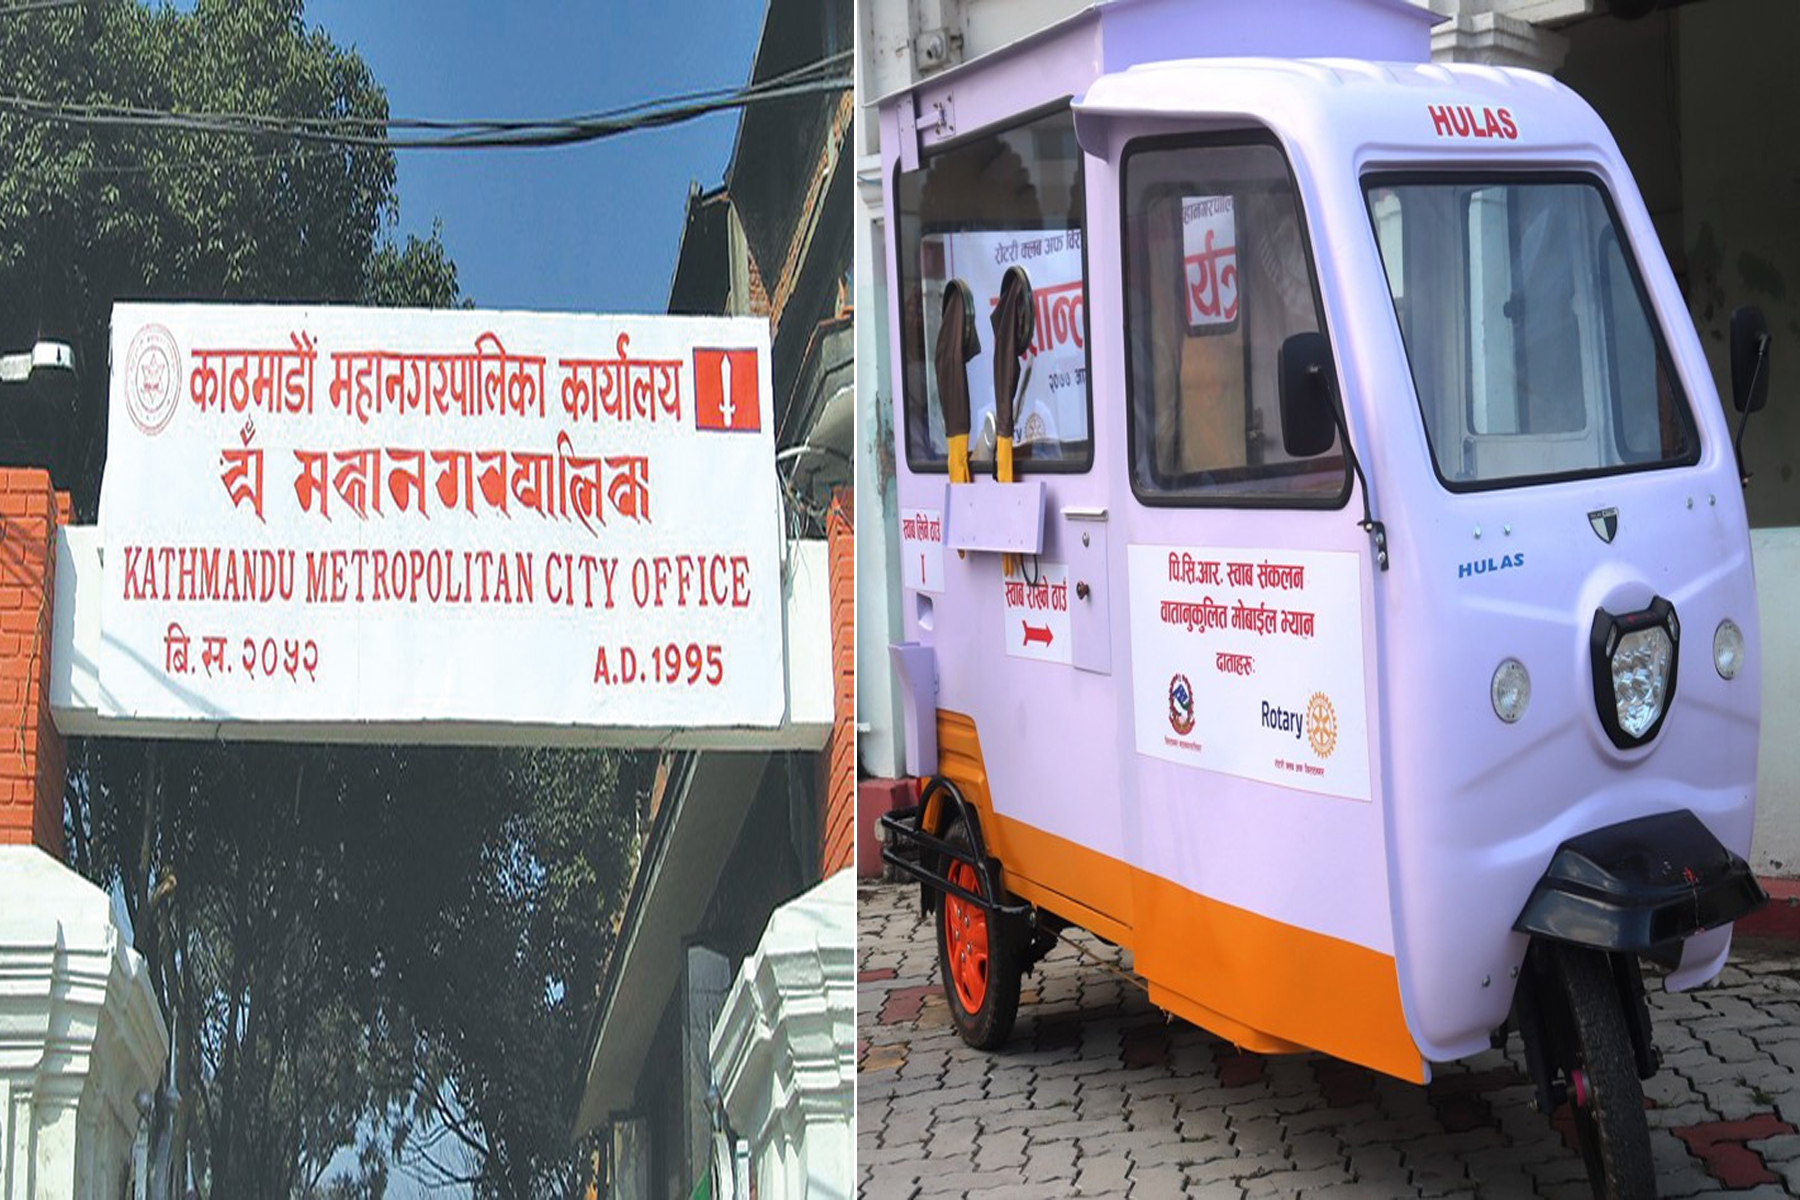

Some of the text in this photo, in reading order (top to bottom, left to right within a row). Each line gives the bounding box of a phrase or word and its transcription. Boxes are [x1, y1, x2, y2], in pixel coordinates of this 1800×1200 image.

[1427, 105, 1518, 139] HULAS
[190, 330, 317, 414] काठमाडौं
[329, 331, 546, 425] महानगरपालिका
[558, 331, 683, 422] कार्यालय
[123, 546, 751, 610] KATHMANDU METROPOLITAN CITY OFFICE
[1226, 562, 1254, 588] स्वाब
[1257, 559, 1305, 590] संकलन
[1458, 552, 1525, 579] HULAS
[1231, 598, 1278, 636] मोबाईल
[1280, 609, 1315, 638] भ्यान
[1261, 700, 1304, 740] Rotary
